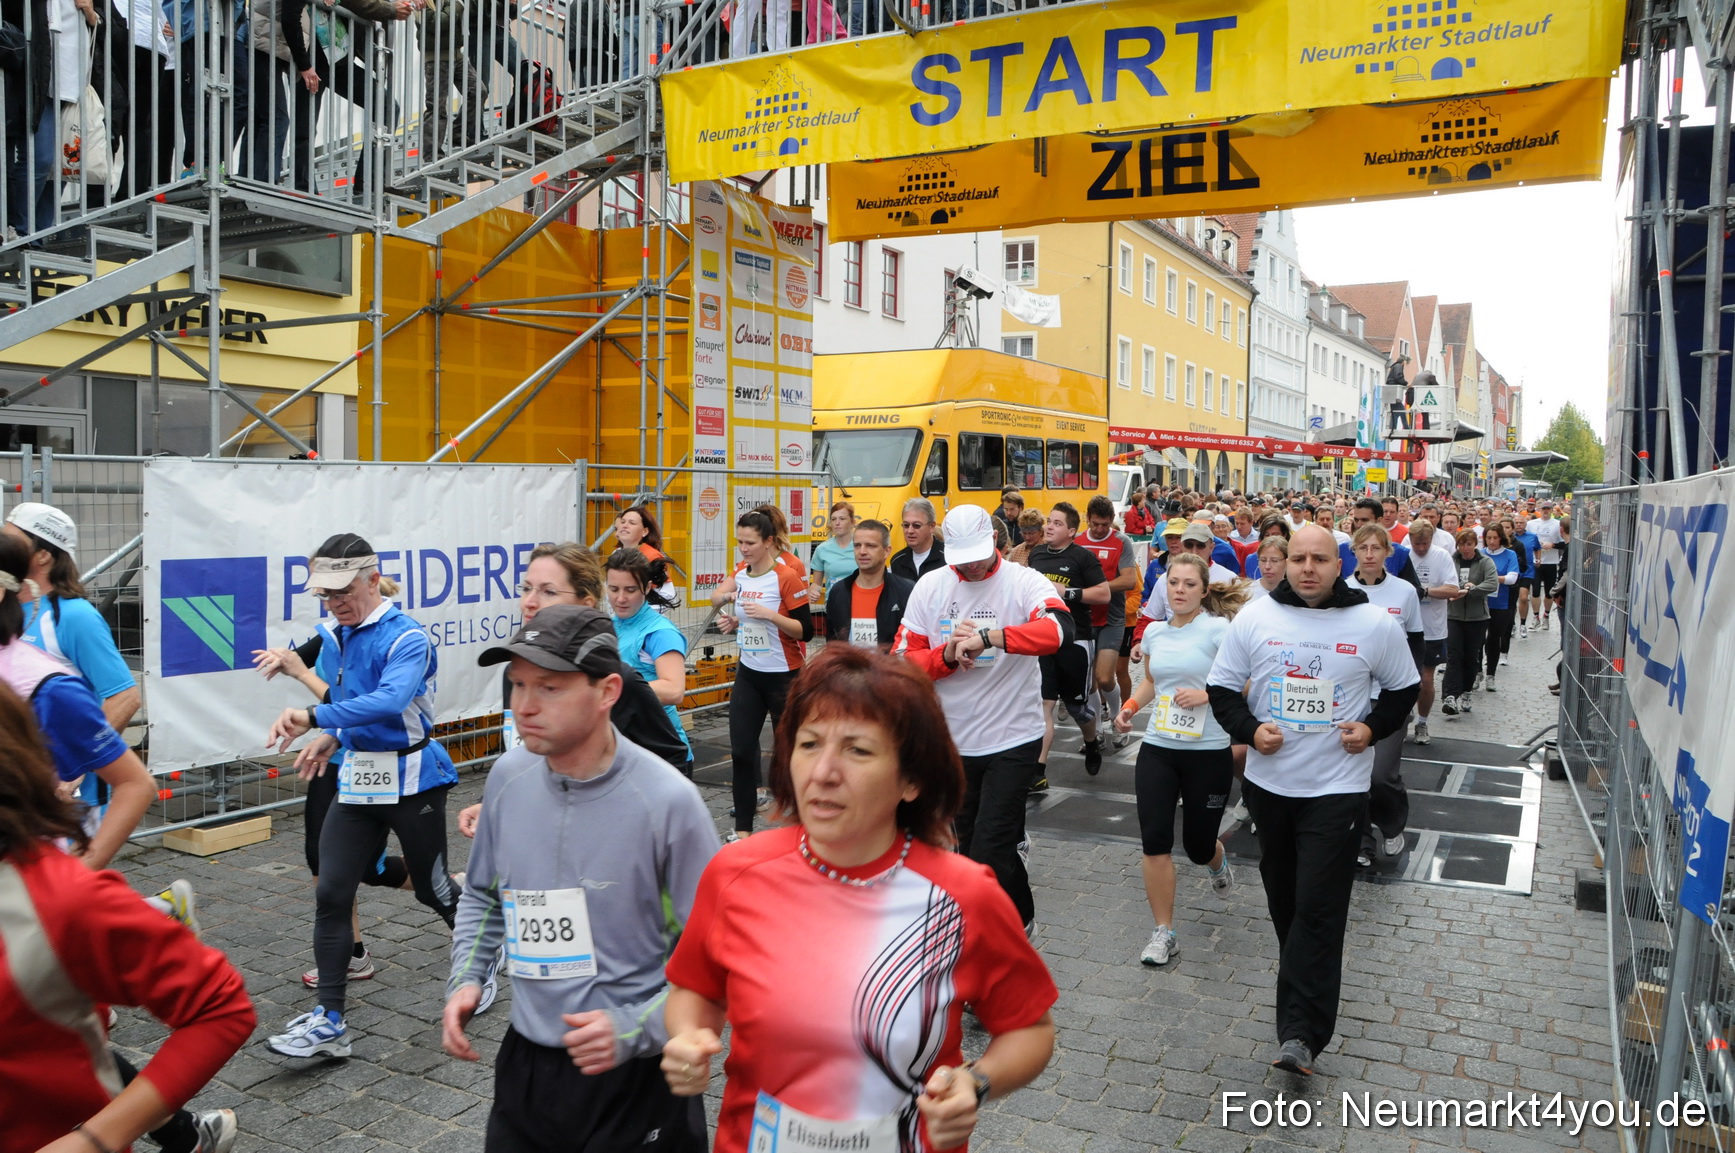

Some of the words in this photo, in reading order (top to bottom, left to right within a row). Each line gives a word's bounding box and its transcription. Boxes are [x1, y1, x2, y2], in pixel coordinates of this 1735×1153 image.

[1300, 36, 1431, 65] Neumarkter
[1439, 14, 1552, 49] Stadtlauf
[909, 16, 1237, 127] START
[698, 116, 782, 144] Neumarkter
[786, 108, 860, 130] Stadtlauf
[1364, 146, 1468, 167] Neumarkter
[1473, 131, 1560, 157] Stadtlauf
[1087, 129, 1260, 200] ZIEL
[856, 193, 933, 210] Neumarkter
[936, 185, 999, 205] Stadtlauf
[773, 221, 813, 240] MERZ
[785, 284, 808, 295] WITTMANN
[146, 300, 268, 345] WEBER
[695, 337, 724, 352] Sinupret
[781, 333, 813, 353] OBI
[695, 352, 712, 364] forte
[781, 388, 803, 403] MCM
[845, 414, 900, 425] TIMING
[1056, 420, 1069, 431] EVENT
[1070, 422, 1086, 432] SERVICE
[1121, 430, 1145, 438] Service
[1184, 435, 1219, 444] Serviceline:
[695, 456, 726, 465] HACKNER
[33, 522, 69, 544] PHONAK
[696, 573, 724, 585] MERZ
[741, 590, 763, 599] MERZ
[744, 636, 764, 645] 2761
[1286, 682, 1318, 694] Dietrich
[1286, 698, 1325, 714] 2753
[1171, 713, 1196, 728] 352
[354, 772, 391, 785] 2526
[520, 917, 574, 943] 2938
[787, 1119, 870, 1150] Elisabeth
